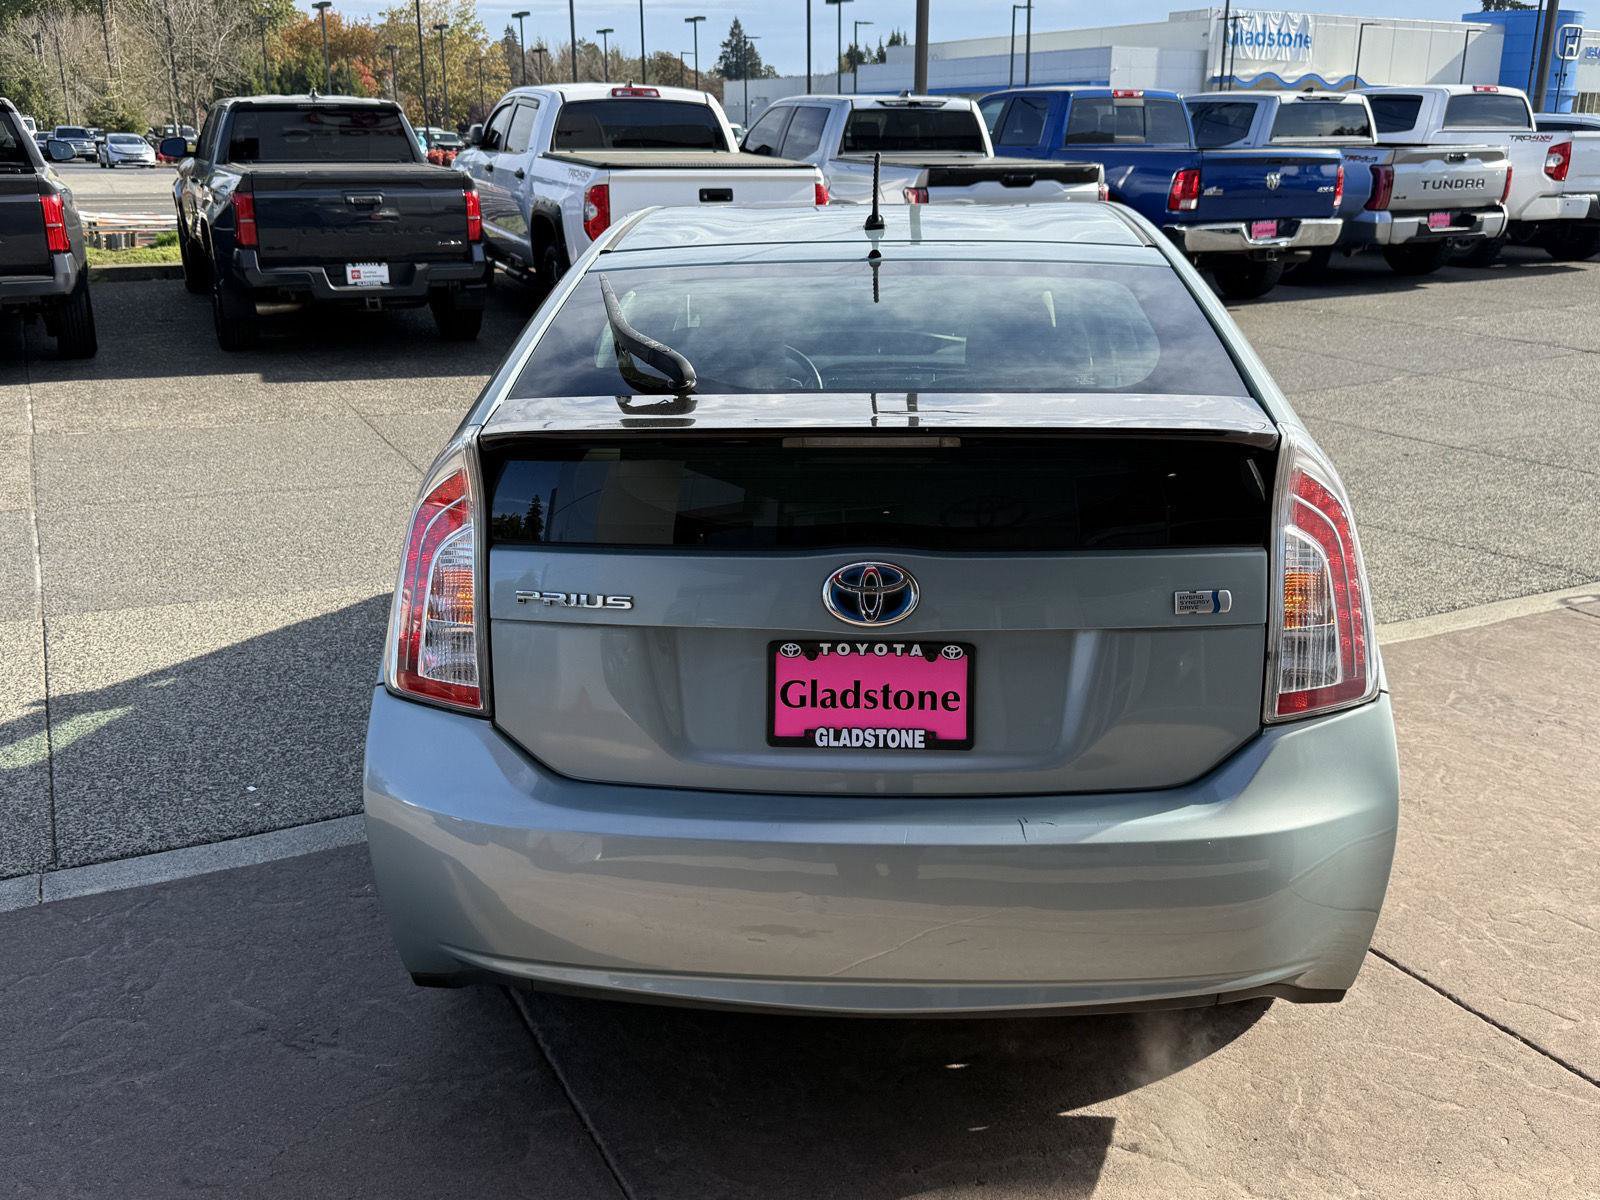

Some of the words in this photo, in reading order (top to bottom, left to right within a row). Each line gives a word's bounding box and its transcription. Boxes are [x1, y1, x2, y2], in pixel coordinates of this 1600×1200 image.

[1421, 178, 1485, 191] TUNDRA
[515, 590, 633, 610] PRIUS
[819, 643, 923, 657] TOYOTA
[779, 679, 961, 712] Gladstone
[815, 727, 926, 749] GLADSTONE
